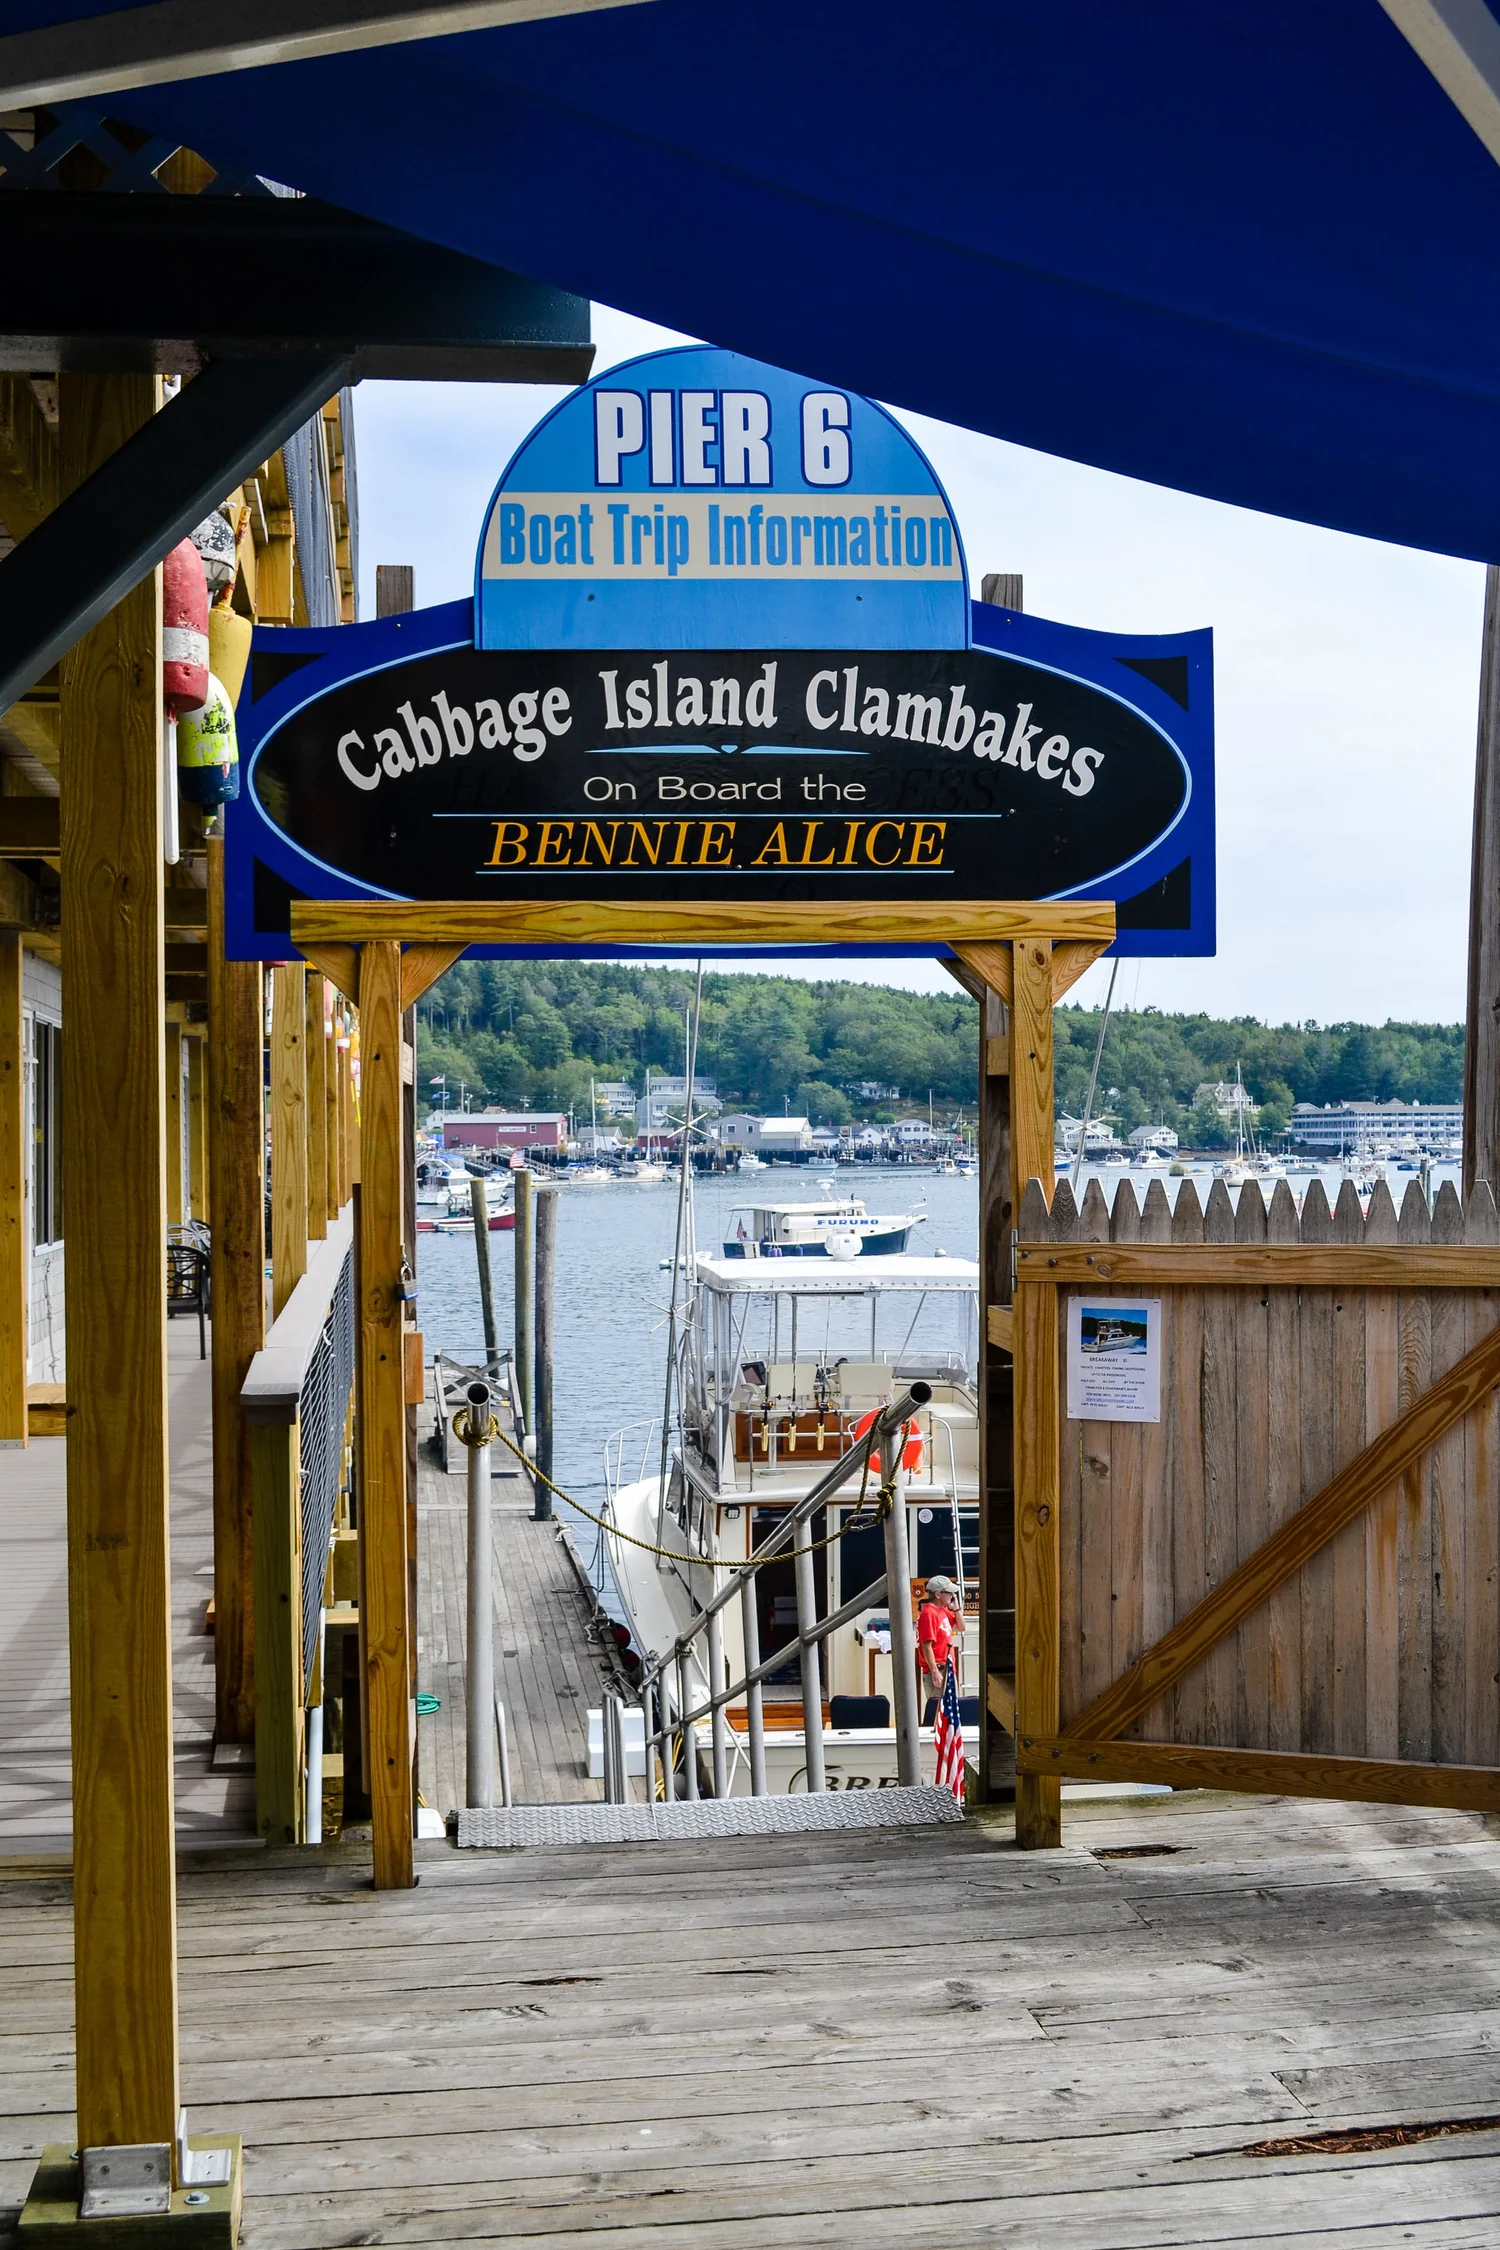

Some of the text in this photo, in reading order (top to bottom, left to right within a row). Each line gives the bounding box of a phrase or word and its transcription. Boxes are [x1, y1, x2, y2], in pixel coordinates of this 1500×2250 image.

[592, 388, 853, 488] PIER 6
[499, 503, 953, 577] Boat Trip Information
[337, 687, 573, 791] Cabbage
[598, 660, 778, 730] Island
[805, 665, 1105, 797] Clambakes
[583, 776, 637, 801] On
[658, 776, 782, 801] Board
[799, 773, 867, 801] the
[484, 821, 947, 865] BENNIE ALICE
